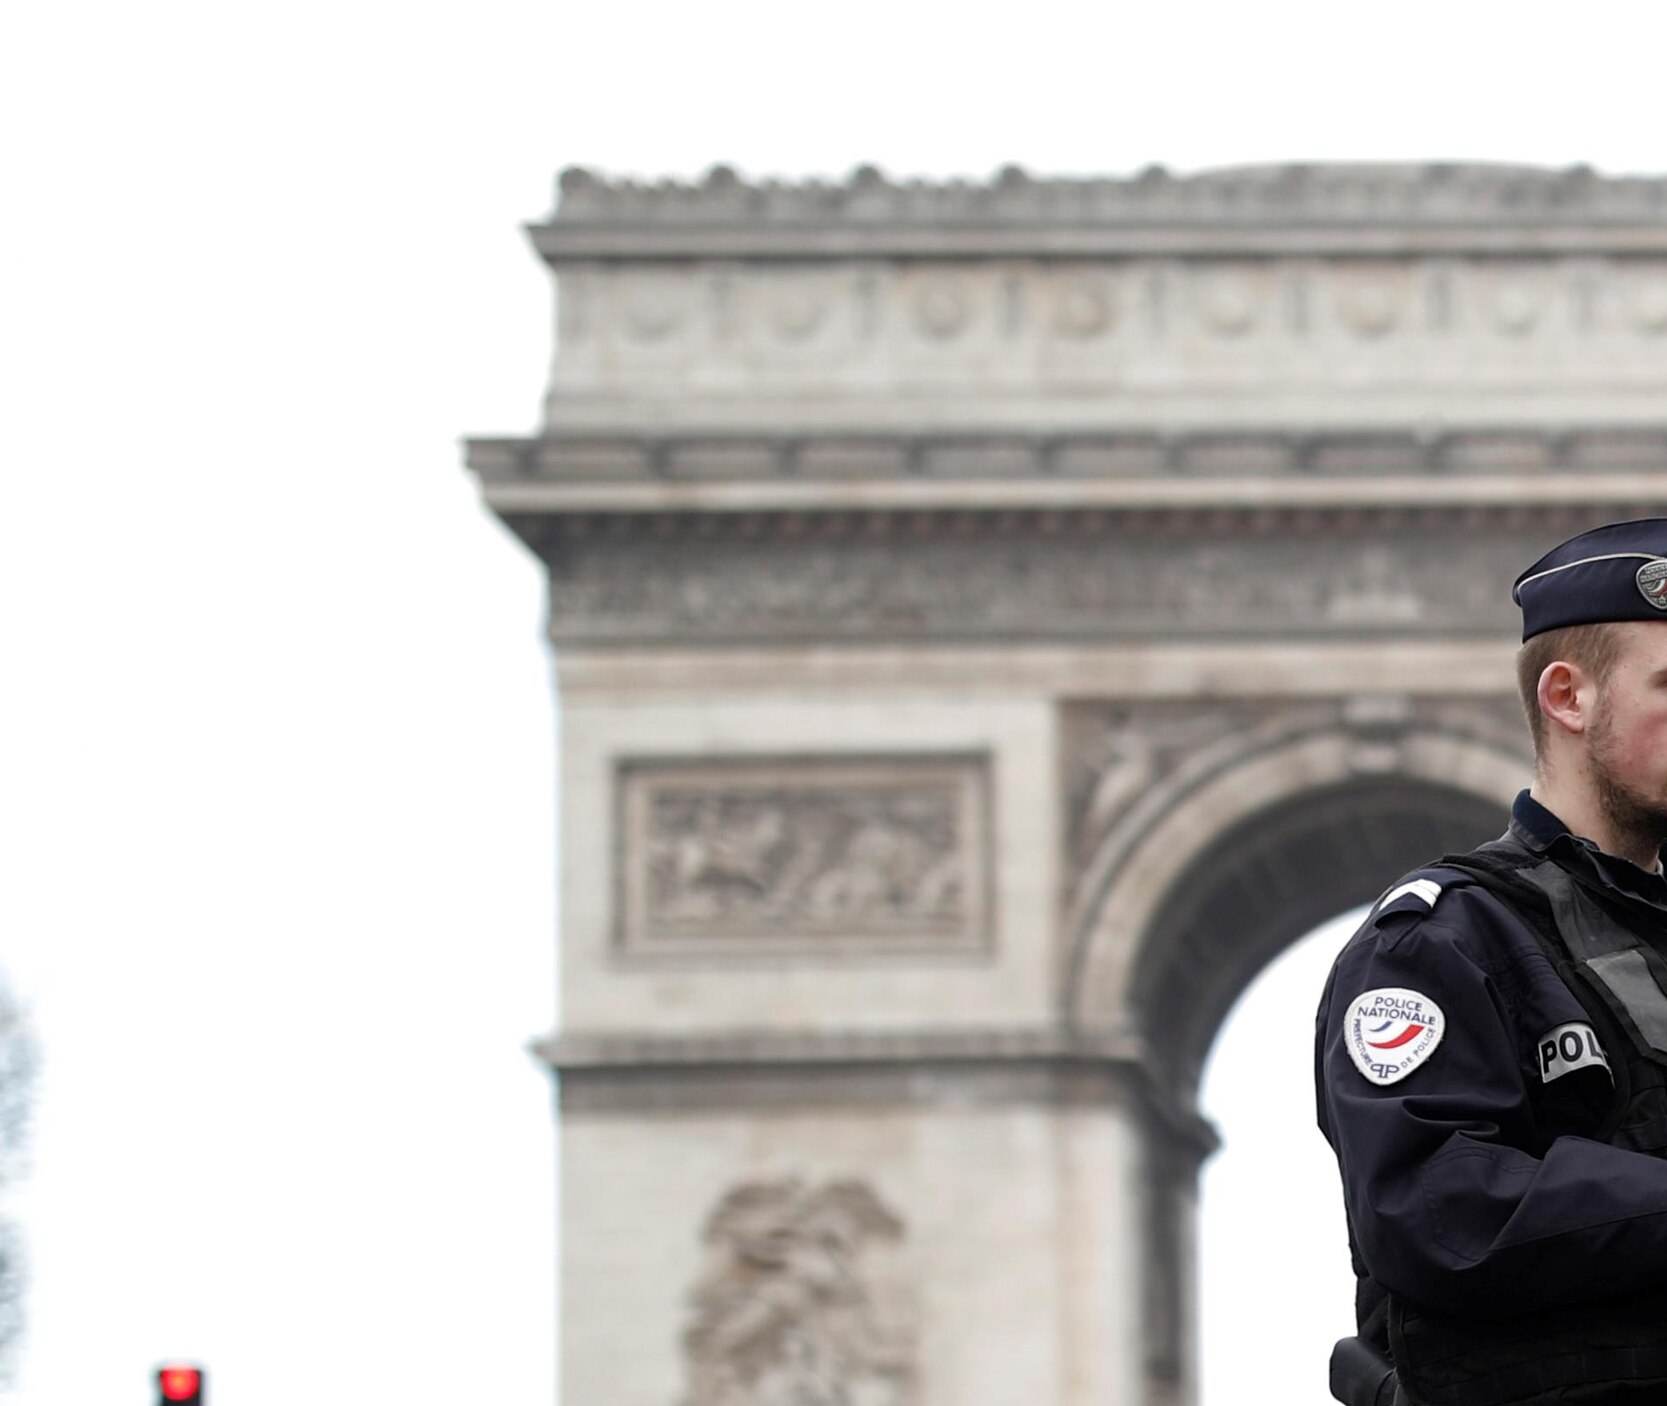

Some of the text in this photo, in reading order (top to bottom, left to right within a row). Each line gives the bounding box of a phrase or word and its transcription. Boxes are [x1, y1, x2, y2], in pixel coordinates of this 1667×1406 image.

[1374, 997, 1423, 1012] POLICE
[1357, 1006, 1437, 1026] NATIONALE
[1400, 1056, 1415, 1069] DE
[1412, 1027, 1437, 1057] POLICE
